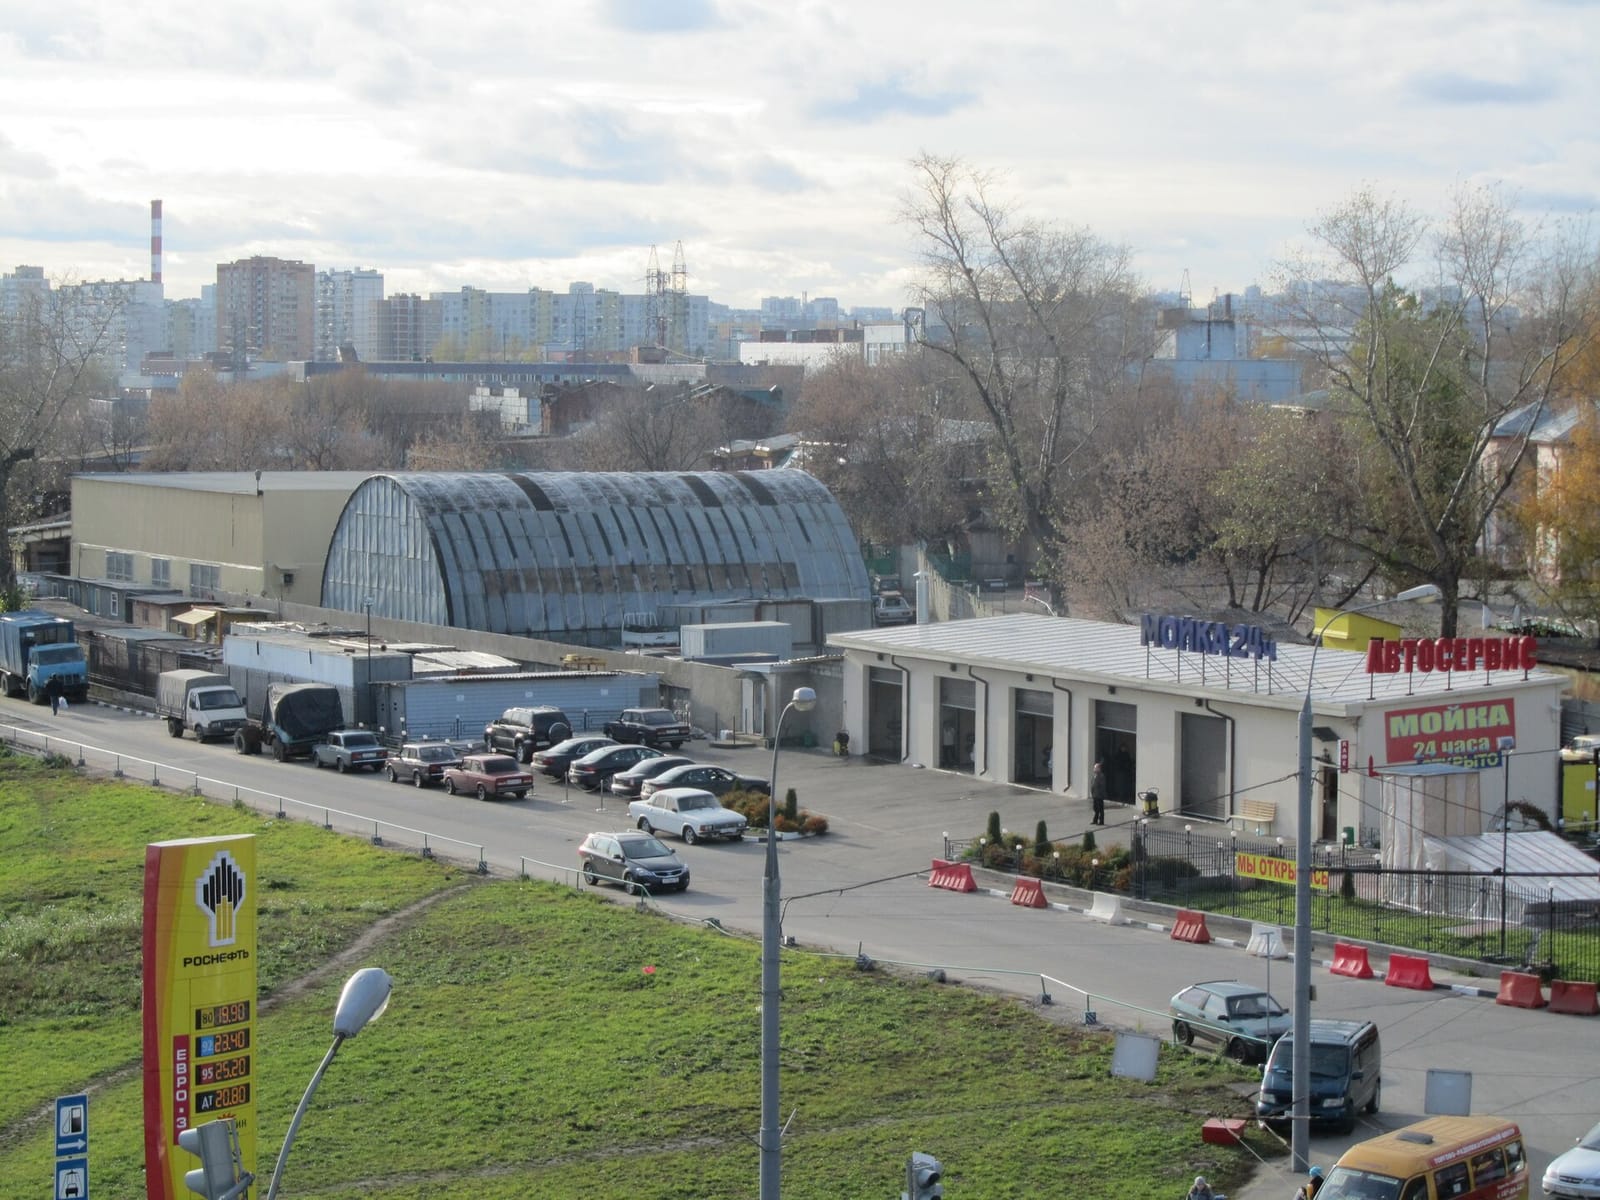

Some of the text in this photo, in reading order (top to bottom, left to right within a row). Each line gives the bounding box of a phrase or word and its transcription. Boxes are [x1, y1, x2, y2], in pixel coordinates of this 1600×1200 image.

[1140, 613, 1230, 656] МОЙКА
[1366, 636, 1537, 674] АВТОСЕРВИС
[1389, 703, 1510, 738] МОЙКА
[1413, 737, 1490, 759] 24 часа
[1237, 854, 1328, 885] МЫ ОТКРЫСЬ
[183, 949, 250, 968] РОСНЕФТЬ
[218, 1003, 245, 1024] 19.90
[215, 1031, 245, 1053] 23.40
[202, 1058, 246, 1080] 95 25.20
[215, 1086, 246, 1108] 20.80
